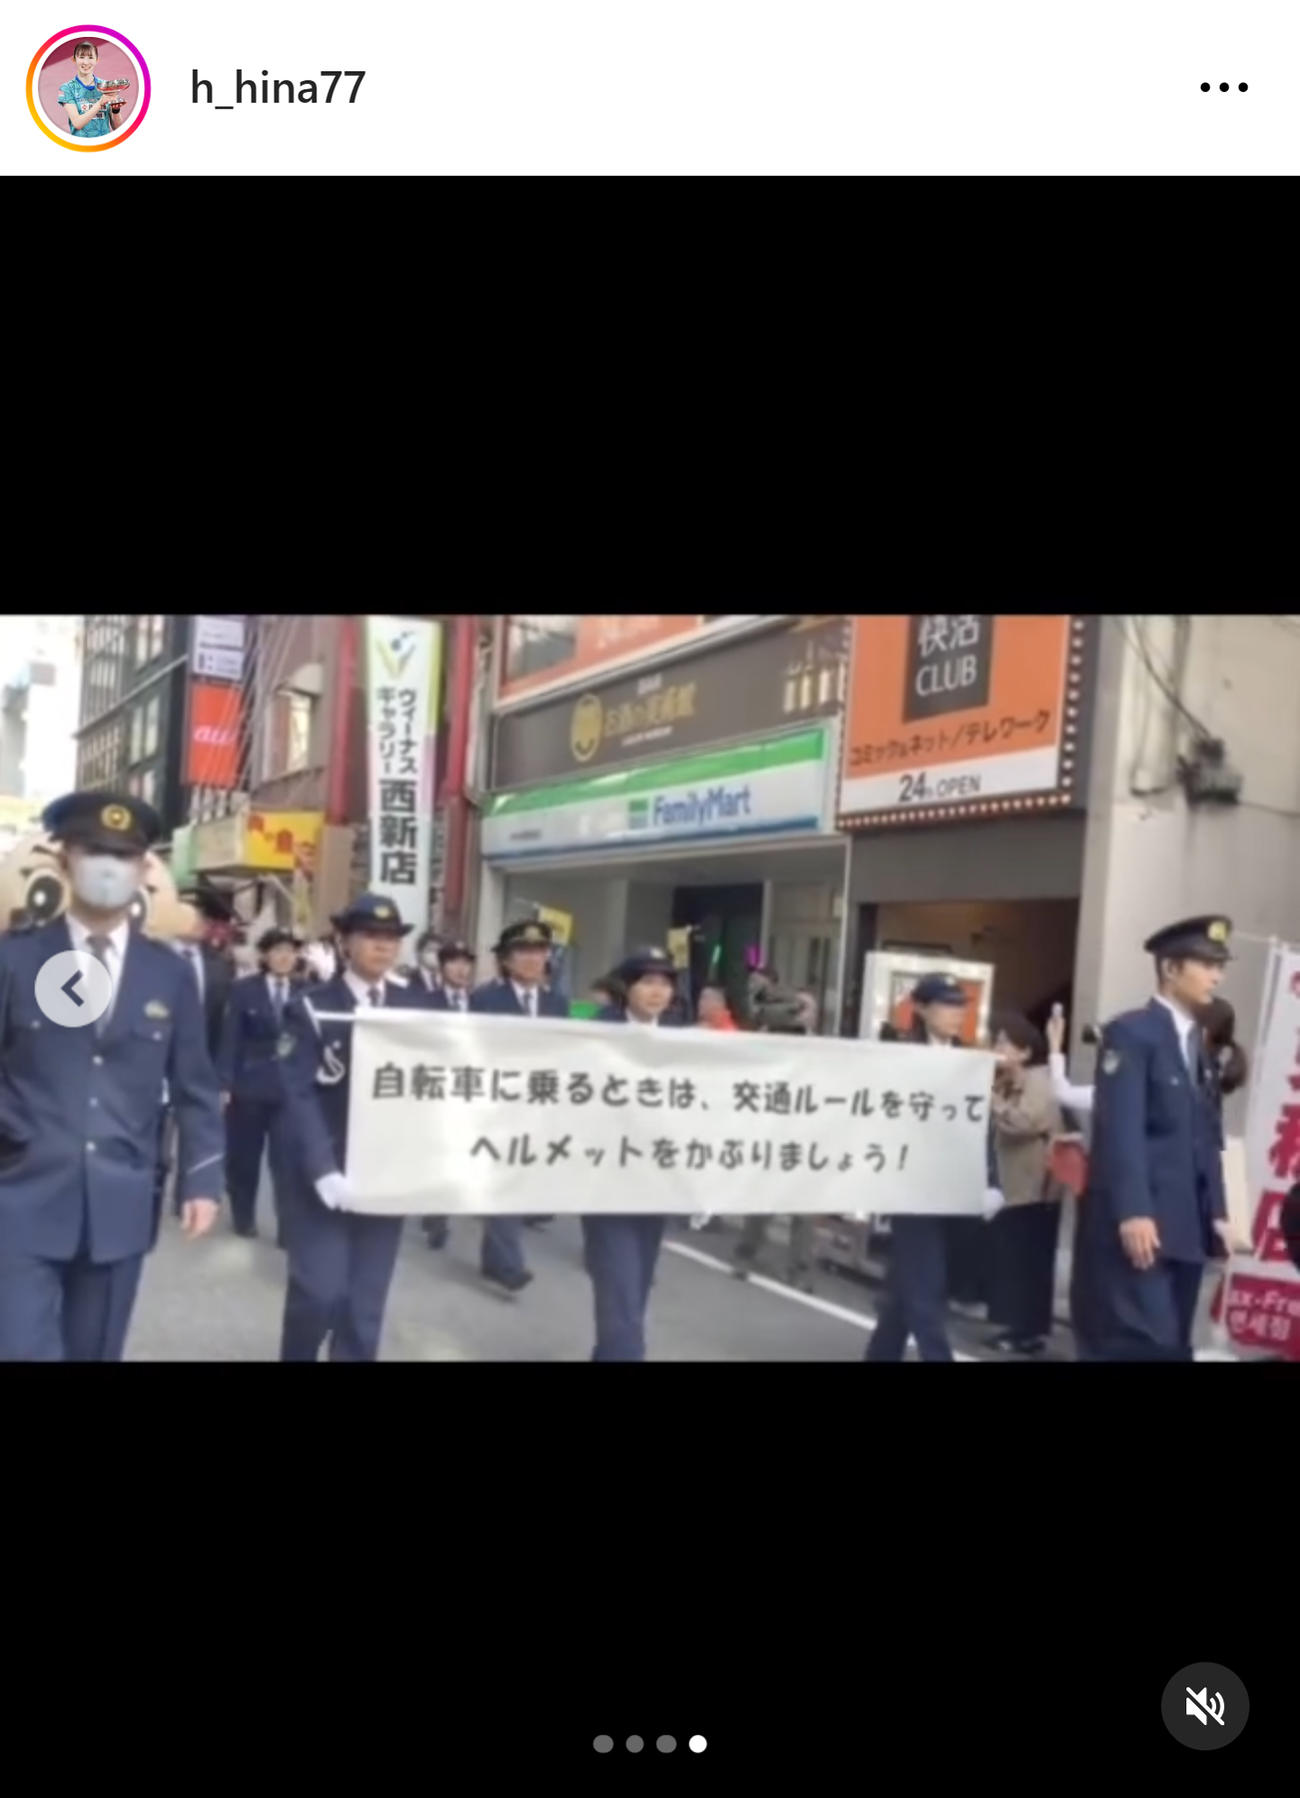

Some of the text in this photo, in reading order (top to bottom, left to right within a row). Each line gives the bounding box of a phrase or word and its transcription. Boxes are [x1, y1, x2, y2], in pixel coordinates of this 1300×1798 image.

[914, 655, 978, 696] CLUB
[653, 785, 751, 829] FamilyMart
[937, 775, 982, 797] OPEN
[380, 780, 417, 884] 西新店
